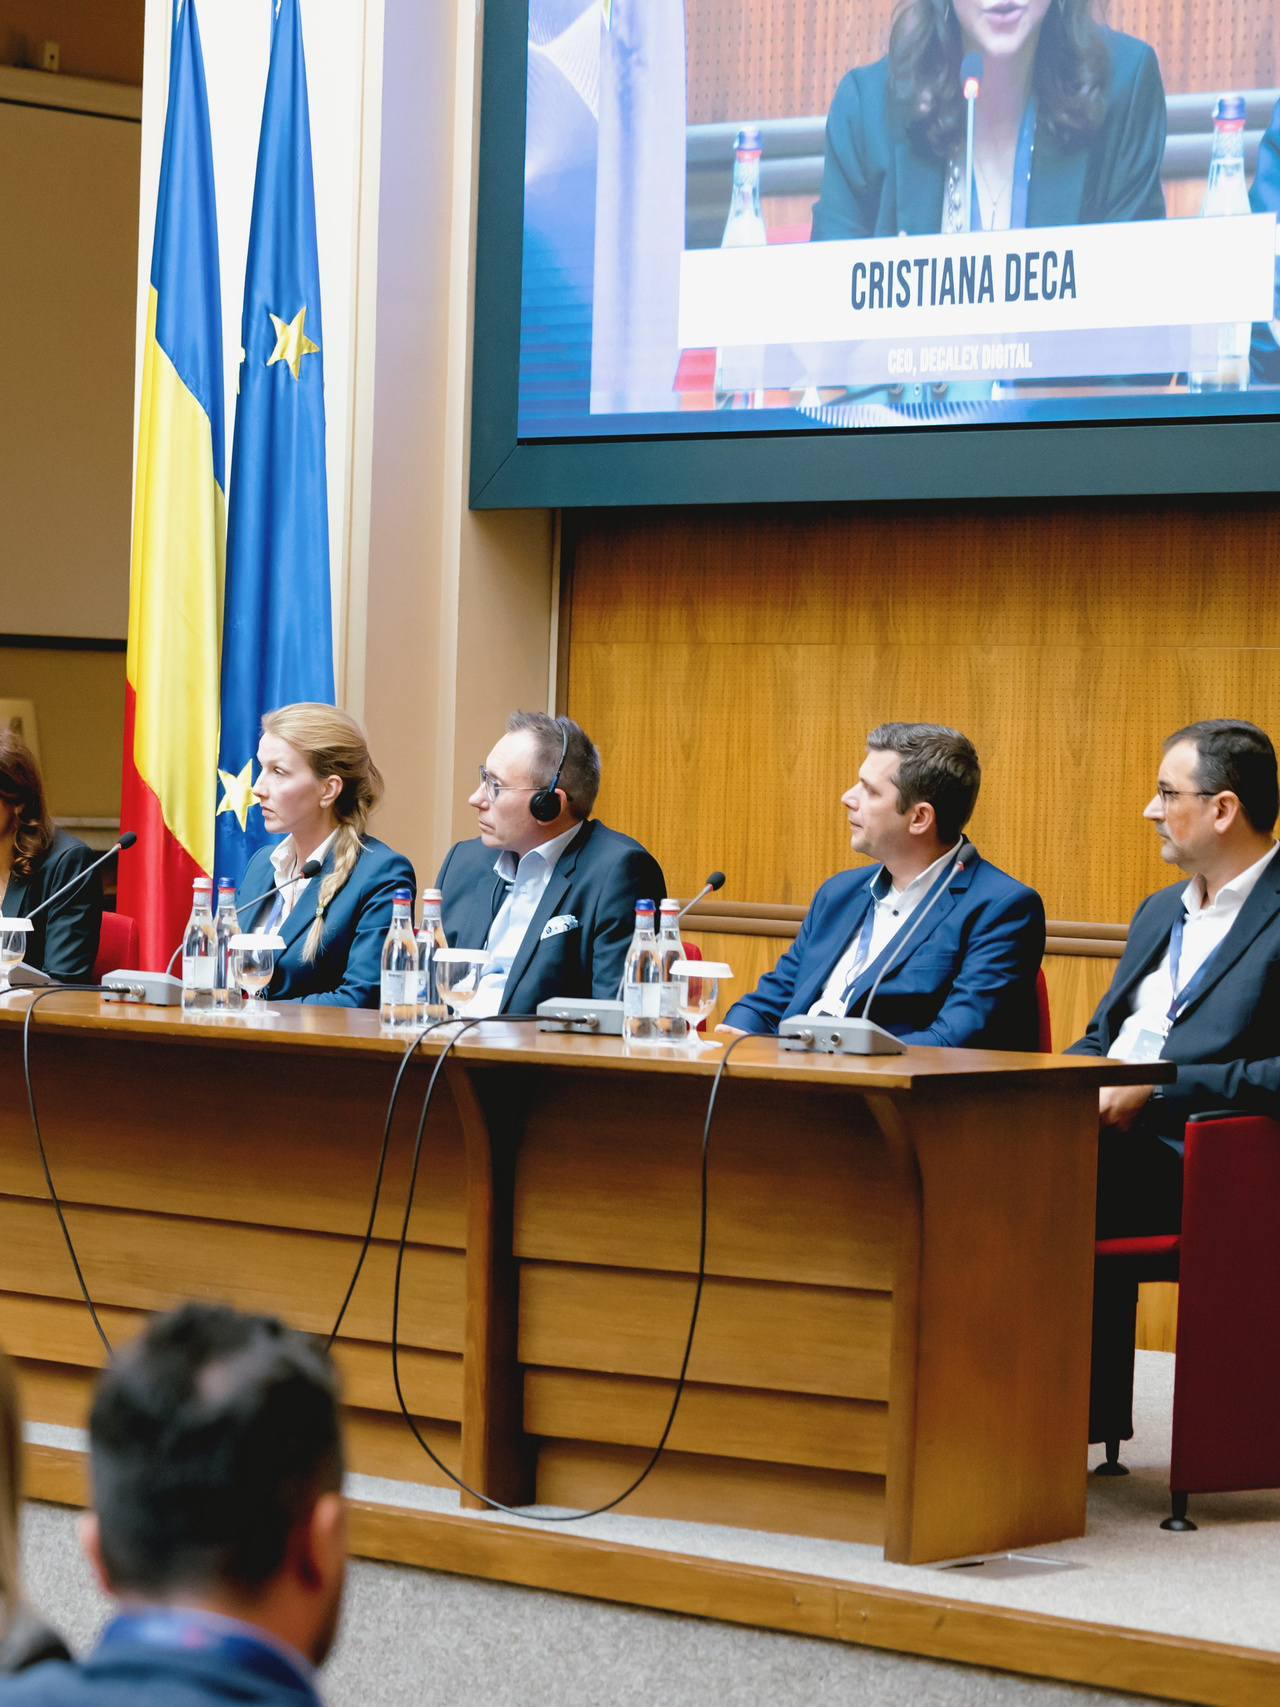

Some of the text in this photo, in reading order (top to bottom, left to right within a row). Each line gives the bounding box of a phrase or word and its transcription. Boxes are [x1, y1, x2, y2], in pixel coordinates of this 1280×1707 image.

[851, 249, 1077, 311] CRISTIANA DECA
[887, 342, 1033, 376] CEO, DECALEX DIGITAL
